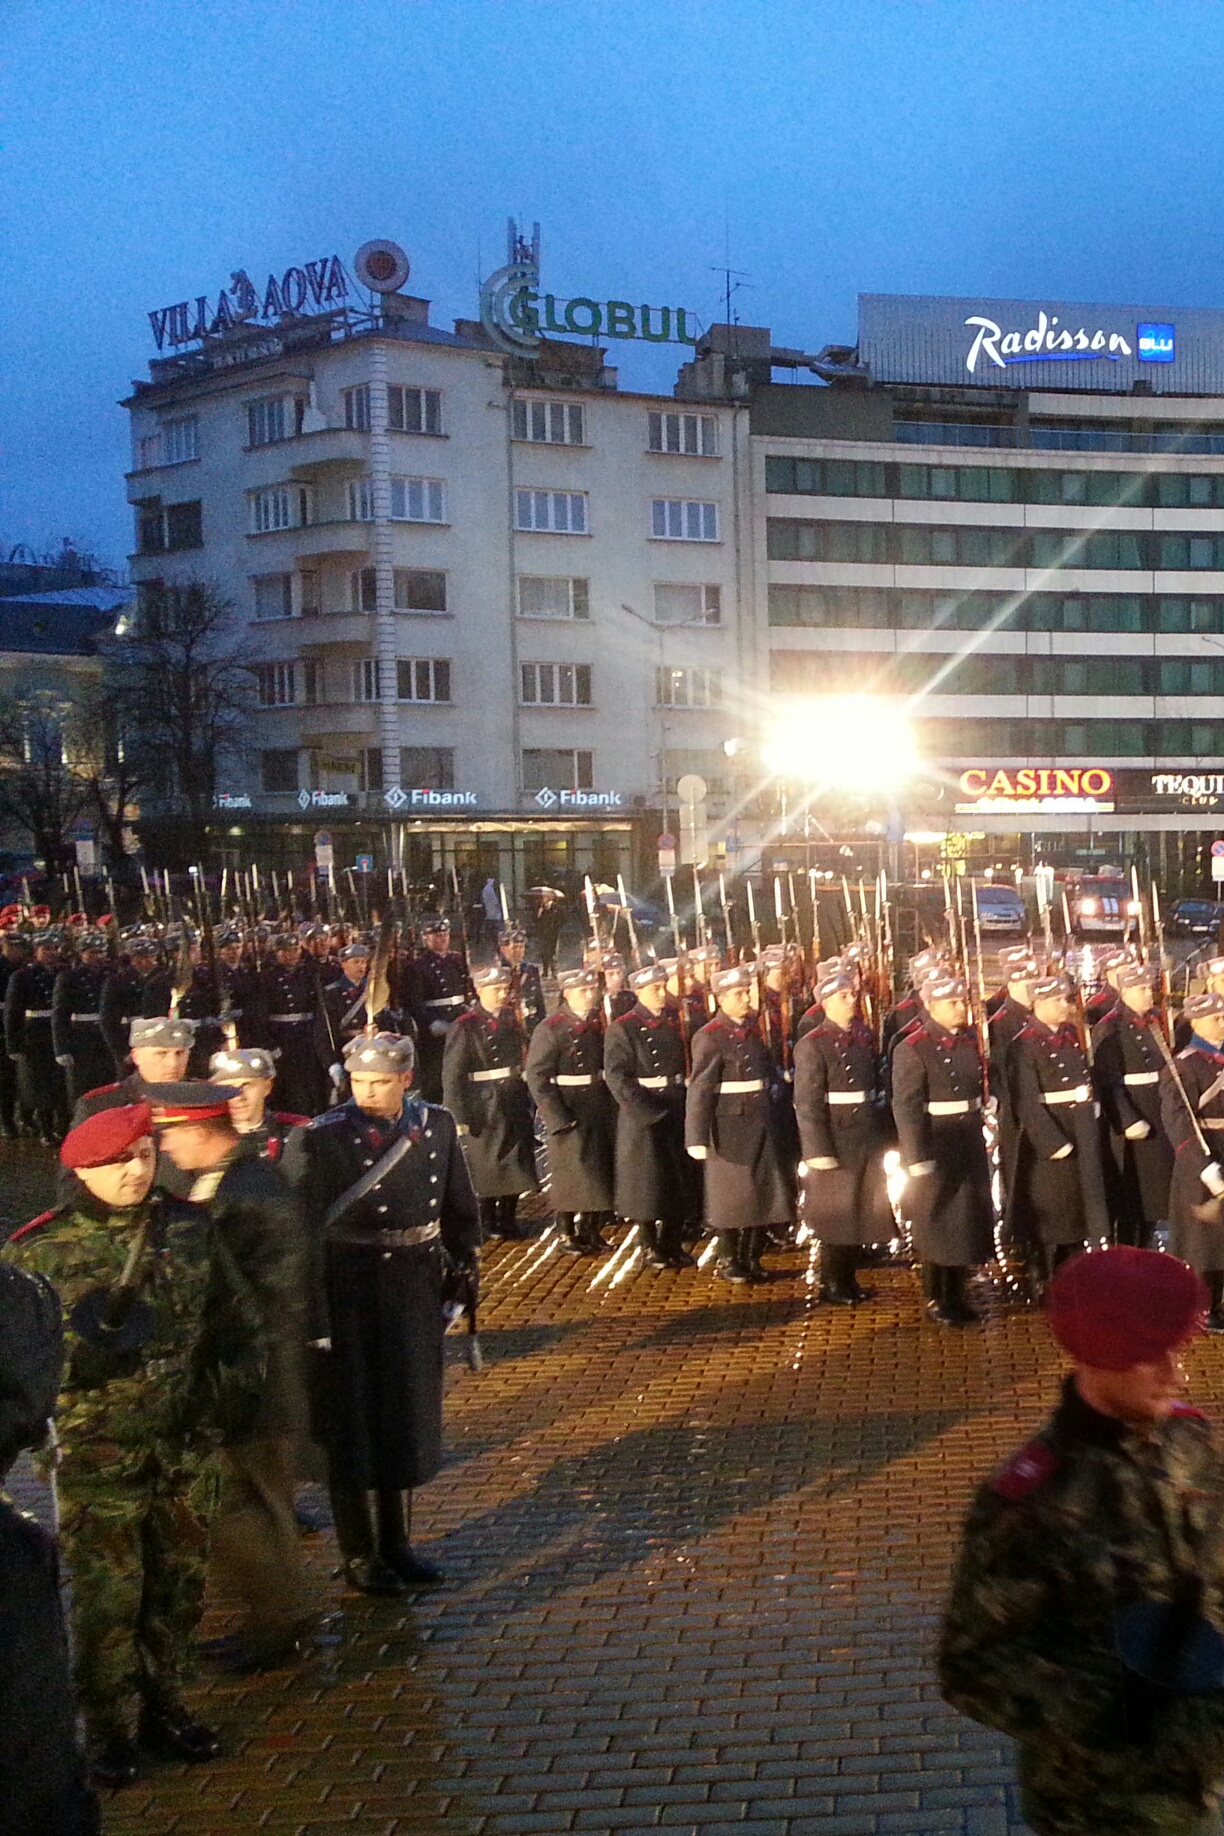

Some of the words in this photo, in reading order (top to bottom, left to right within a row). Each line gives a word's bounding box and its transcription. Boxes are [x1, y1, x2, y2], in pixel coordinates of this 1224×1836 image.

[508, 291, 697, 346] GLOBUL
[964, 310, 1132, 374] Radisson
[959, 769, 1112, 796] CASINO
[311, 789, 349, 806] Fibank
[411, 788, 478, 805] Fibank
[560, 789, 621, 806] Fibank
